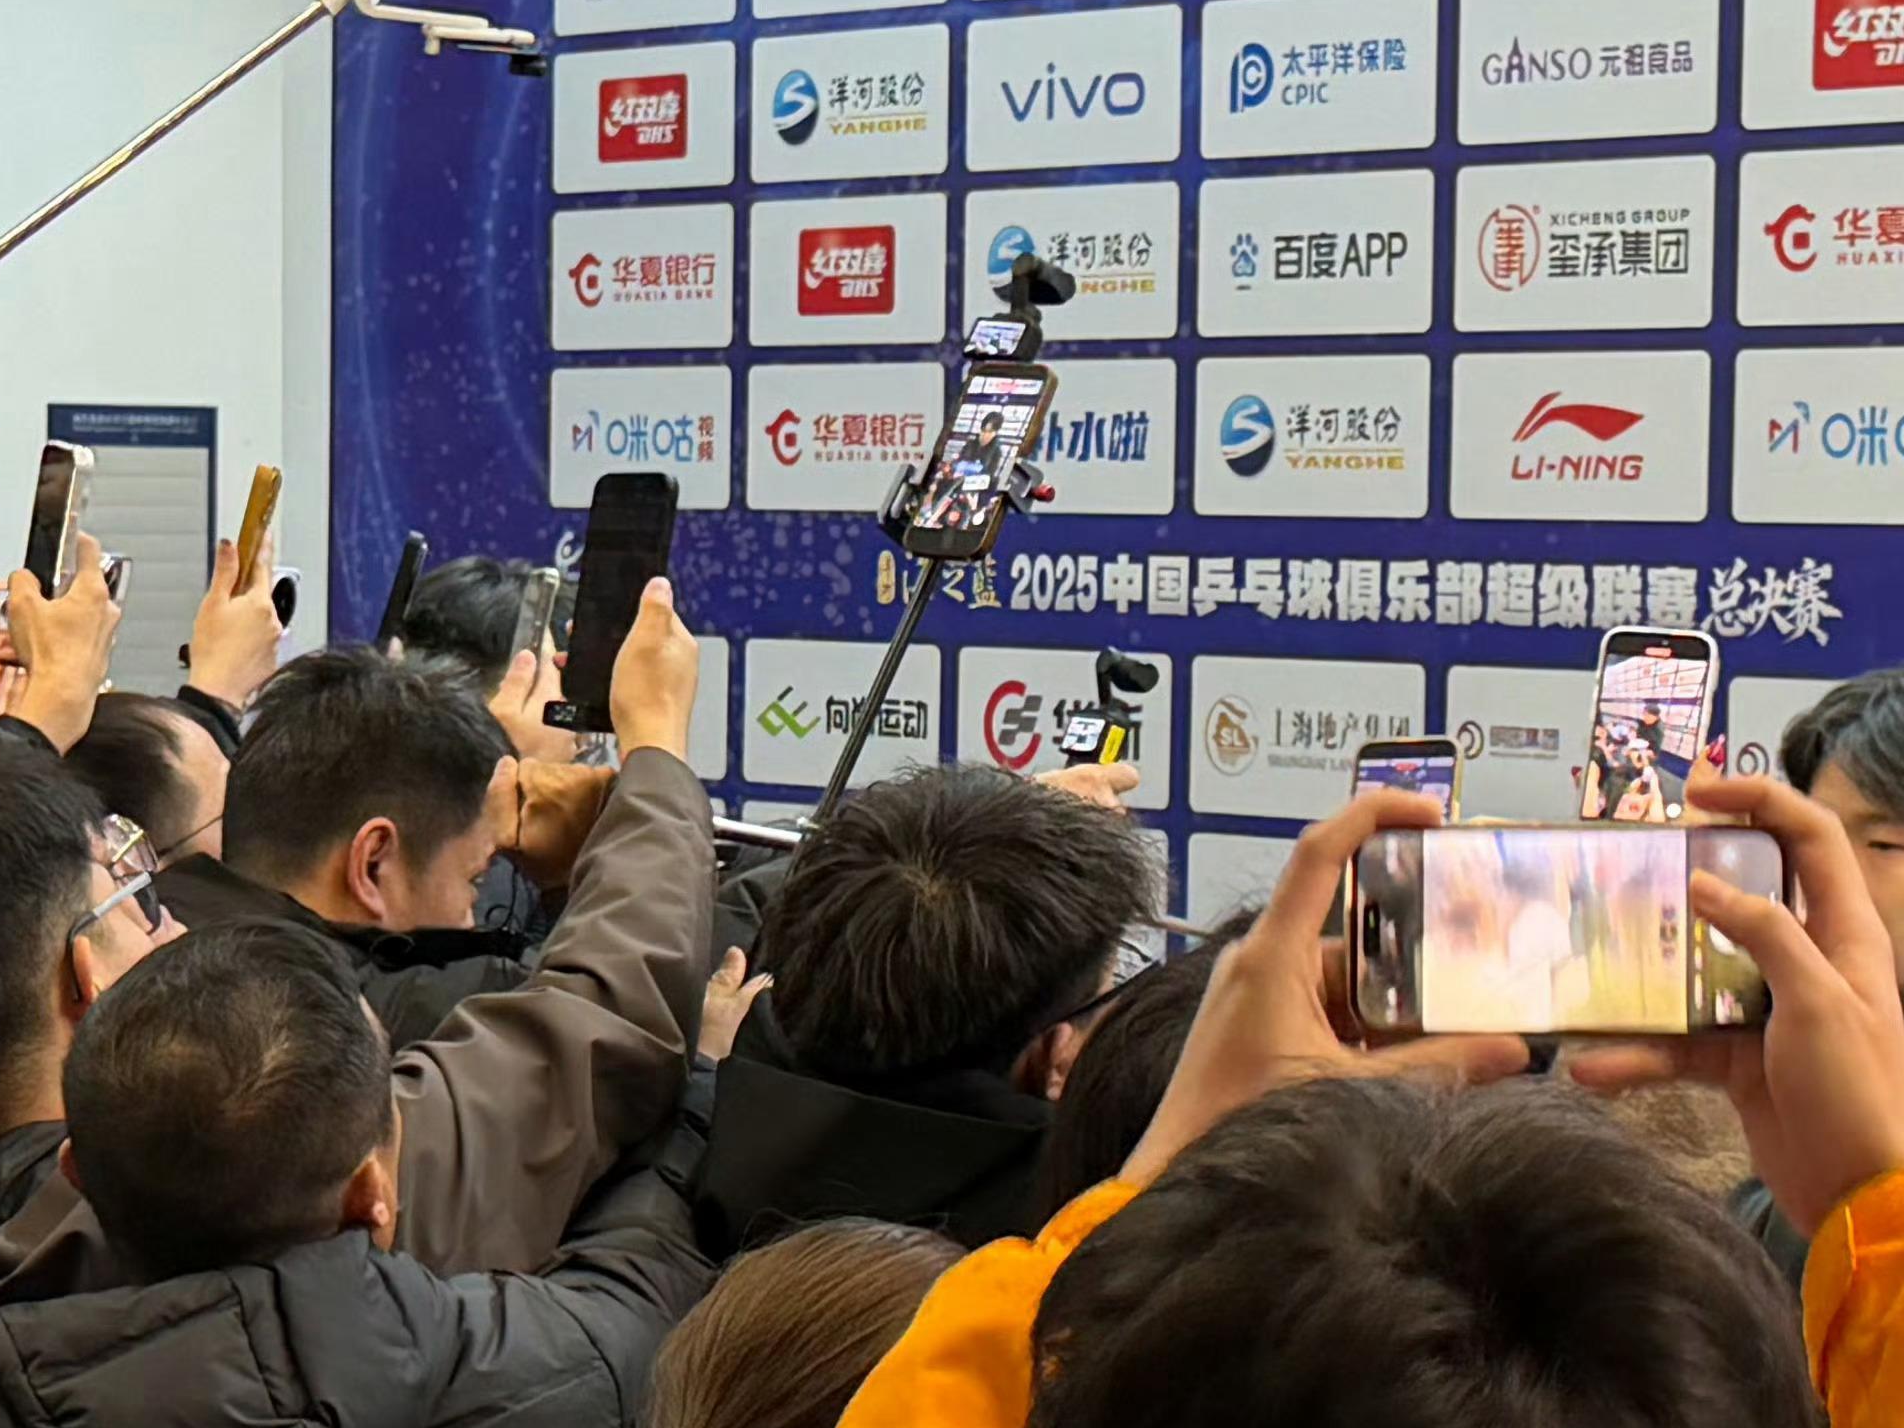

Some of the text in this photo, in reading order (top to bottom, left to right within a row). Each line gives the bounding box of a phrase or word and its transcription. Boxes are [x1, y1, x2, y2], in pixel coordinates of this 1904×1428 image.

[1281, 37, 1408, 78] 太平洋保险
[1481, 36, 1694, 86] GANSO 元祖食品
[828, 72, 925, 112] 洋河股份
[1000, 62, 1147, 122] vivo
[1281, 81, 1329, 107] CPIC
[828, 115, 928, 136] YANGHE
[1549, 208, 1692, 228] XICHENG GROUP
[611, 252, 718, 287] 华夏银行
[1047, 231, 1153, 271] 洋河股份
[1272, 230, 1408, 281] 百度APP
[1547, 228, 1691, 278] 玺承集团
[1079, 275, 1157, 294] NGHE
[812, 413, 926, 449] 华夏银行
[1286, 405, 1402, 446] 洋河股份
[1285, 453, 1406, 471] YANGHE
[1510, 454, 1645, 483] LI-NING
